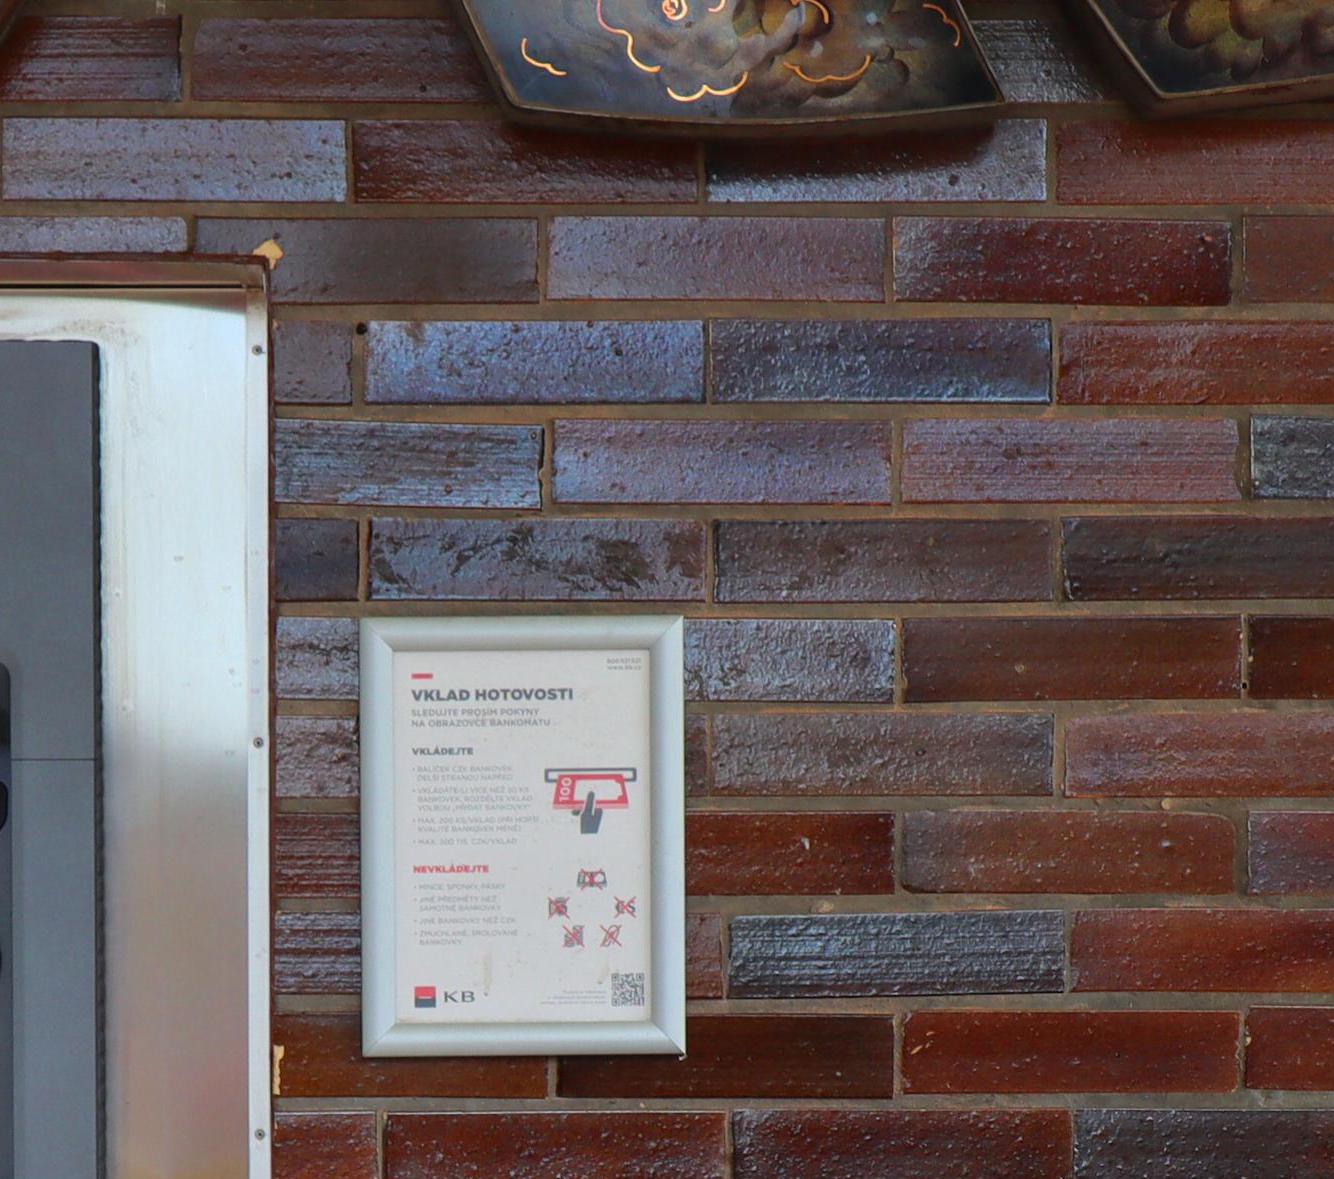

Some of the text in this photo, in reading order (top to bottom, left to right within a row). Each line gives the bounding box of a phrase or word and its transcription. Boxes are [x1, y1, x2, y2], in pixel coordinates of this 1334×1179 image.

[411, 688, 573, 701] VKLAD HOTOVOSTI
[411, 707, 540, 717] SLEDUJTE PROSÍM POKYNY
[411, 718, 551, 727] NA OBRAZOVCE BANKOMATU
[411, 746, 474, 756] VKLÁDEJTE
[558, 777, 572, 802] 100
[412, 864, 490, 873] NEVKLÁDEJTE
[443, 991, 476, 1003] KB
